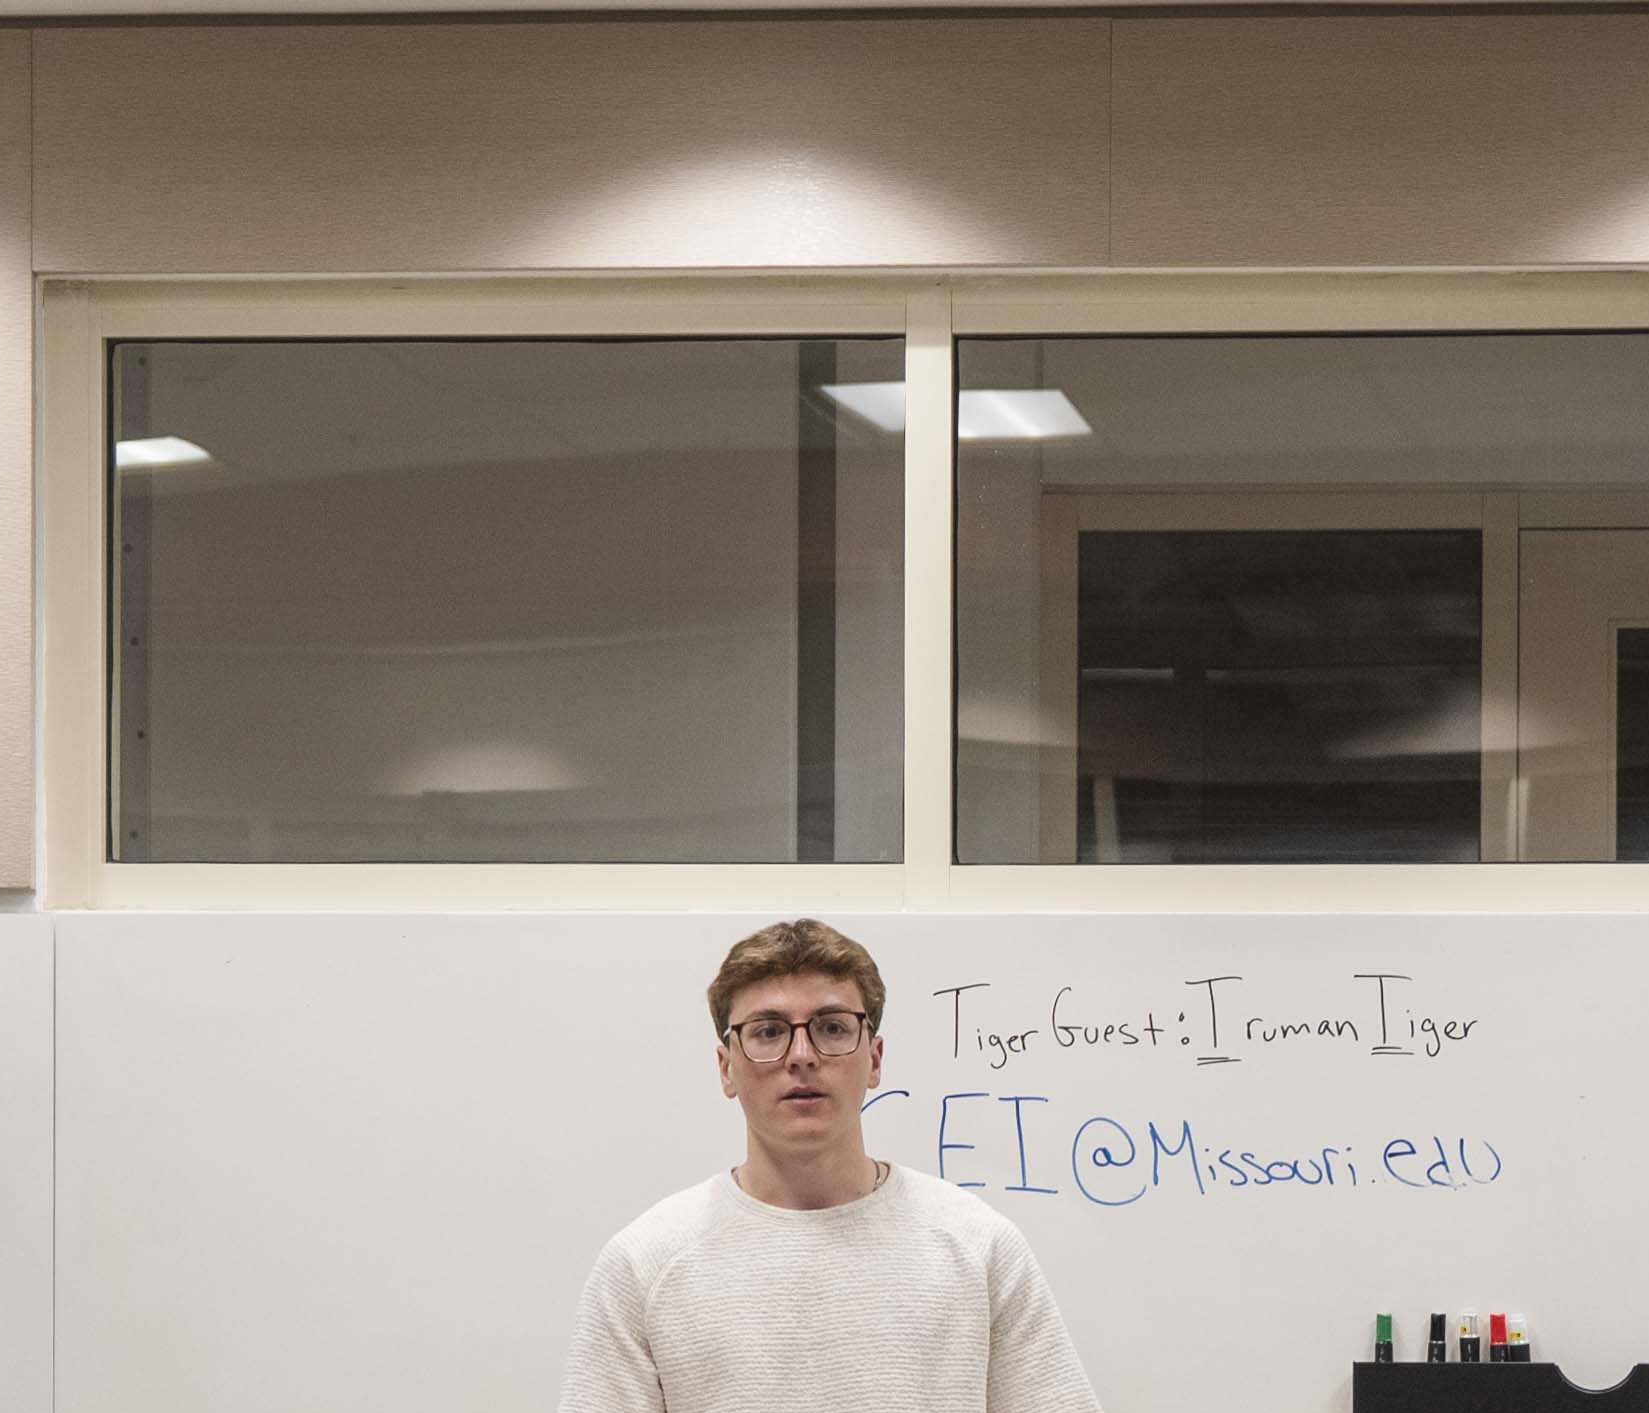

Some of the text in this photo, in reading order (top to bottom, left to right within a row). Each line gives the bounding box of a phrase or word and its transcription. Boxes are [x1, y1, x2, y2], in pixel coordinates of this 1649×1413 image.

[934, 983, 1038, 1069] Tiger
[1052, 986, 1190, 1047] Guest:
[1354, 975, 1479, 1059] Tiger
